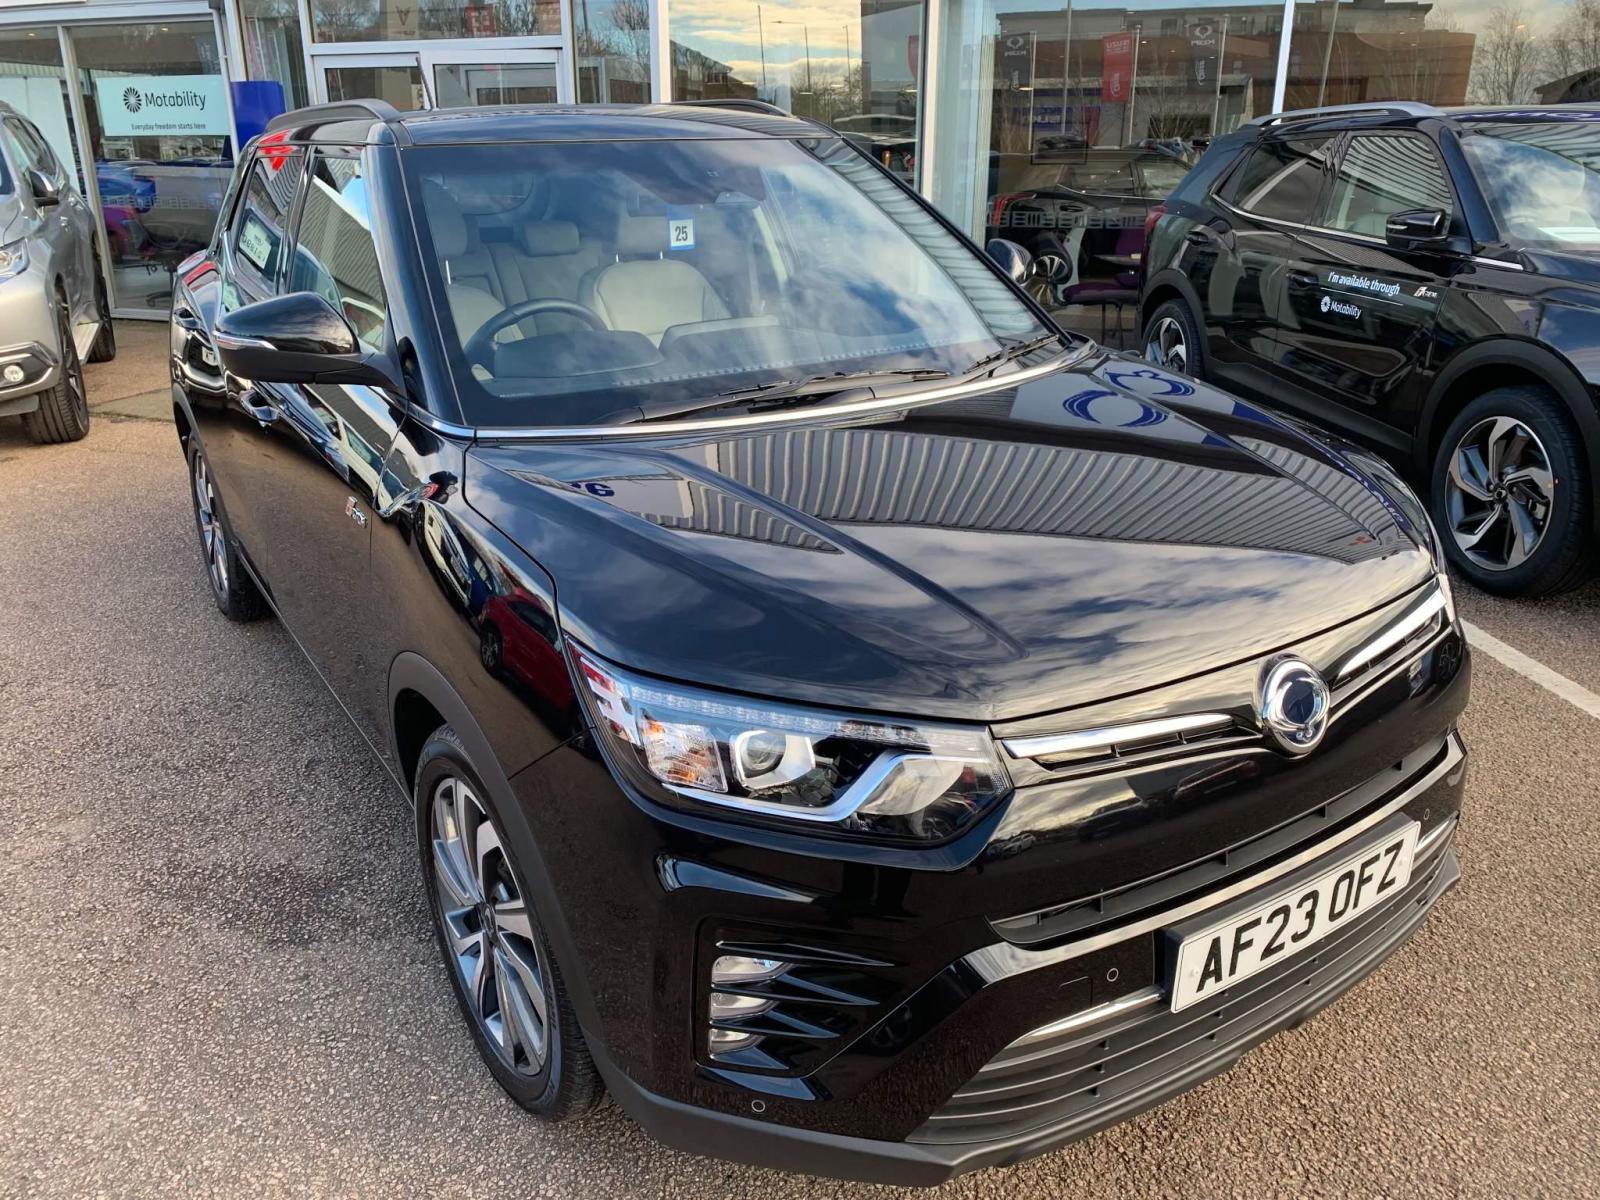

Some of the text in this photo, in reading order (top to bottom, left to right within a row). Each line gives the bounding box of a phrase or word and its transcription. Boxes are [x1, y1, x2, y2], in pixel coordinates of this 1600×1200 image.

[145, 91, 206, 111] Motability
[675, 225, 688, 242] 25
[1327, 271, 1338, 283] I'm
[1339, 274, 1370, 289] available
[1370, 280, 1400, 297] through
[1330, 301, 1362, 319] Motability
[1196, 838, 1405, 994] AF23 OFZ
